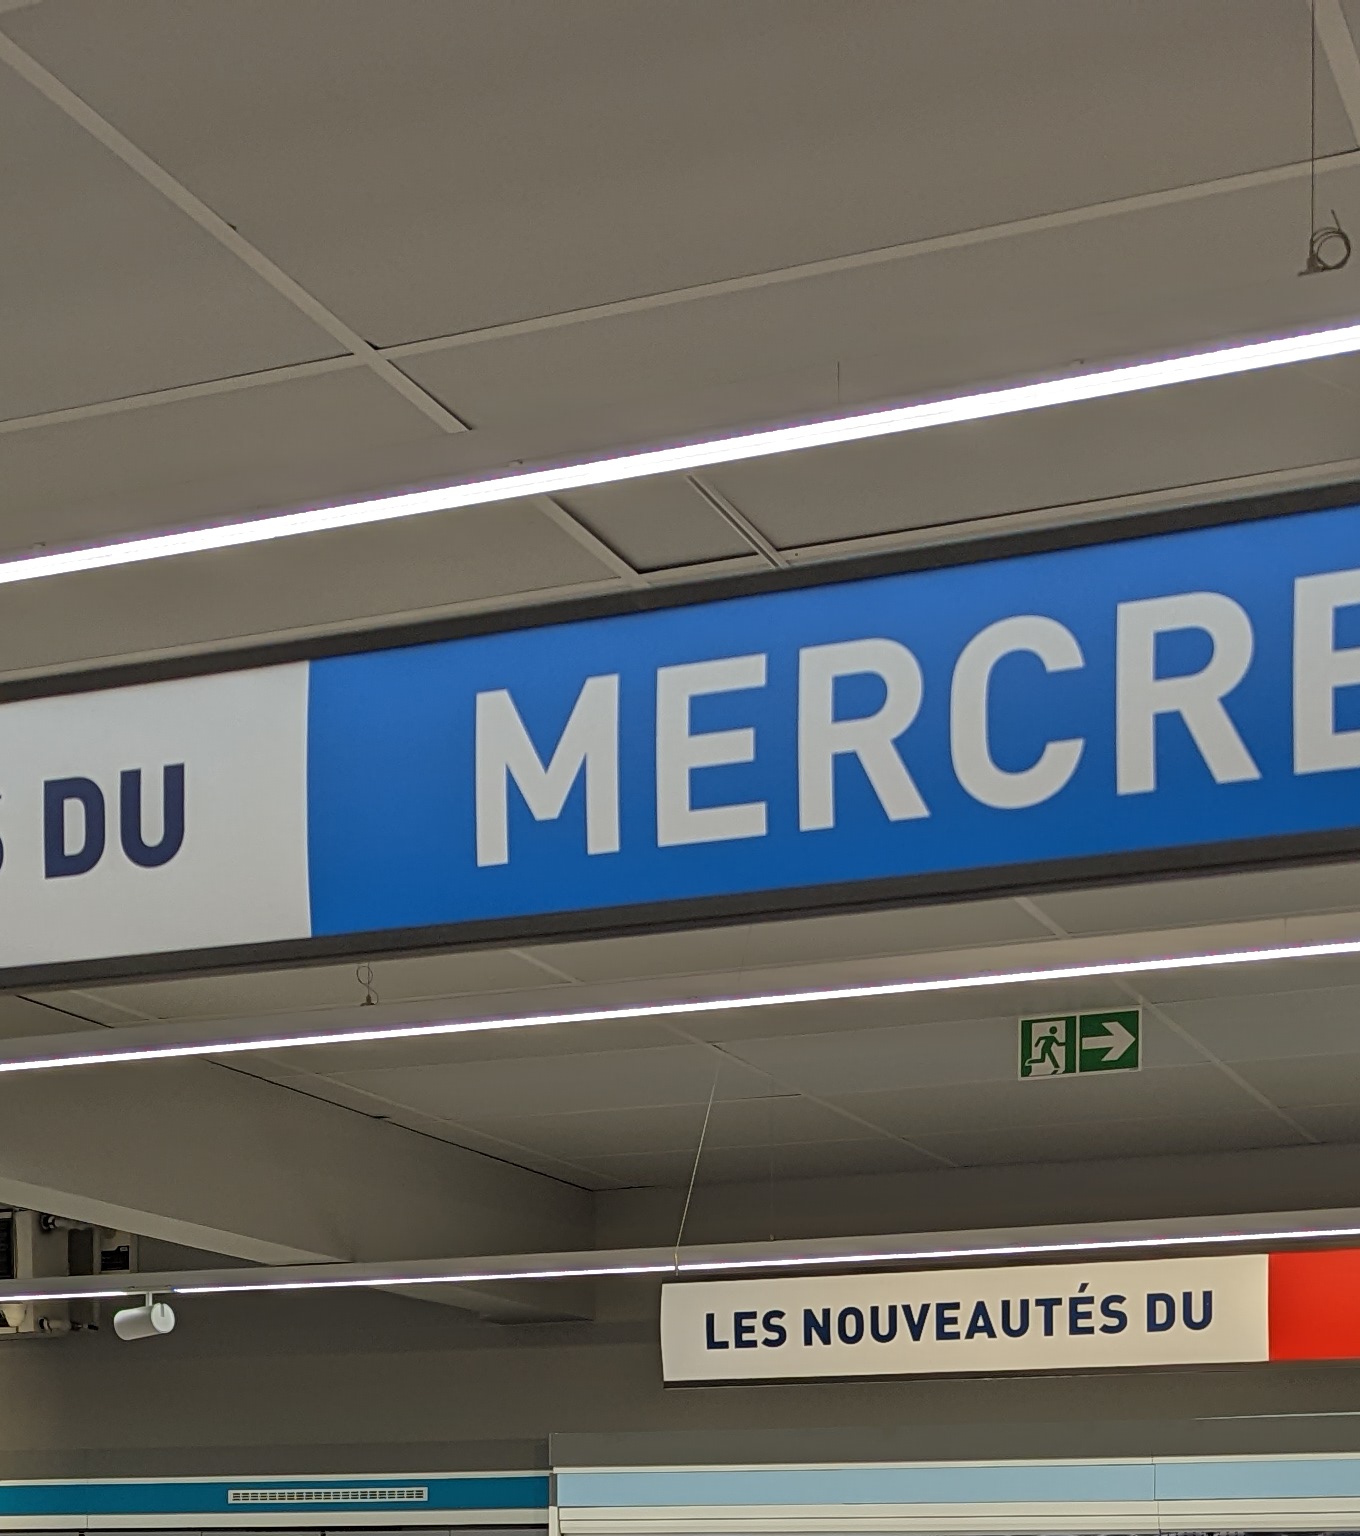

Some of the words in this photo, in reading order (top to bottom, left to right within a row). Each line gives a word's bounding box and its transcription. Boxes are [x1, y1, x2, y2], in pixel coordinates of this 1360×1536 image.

[42, 763, 187, 880] DU
[705, 1308, 788, 1351] LES
[803, 1282, 1128, 1347] NOUVEAUTÉS
[1145, 1290, 1214, 1333] DU
